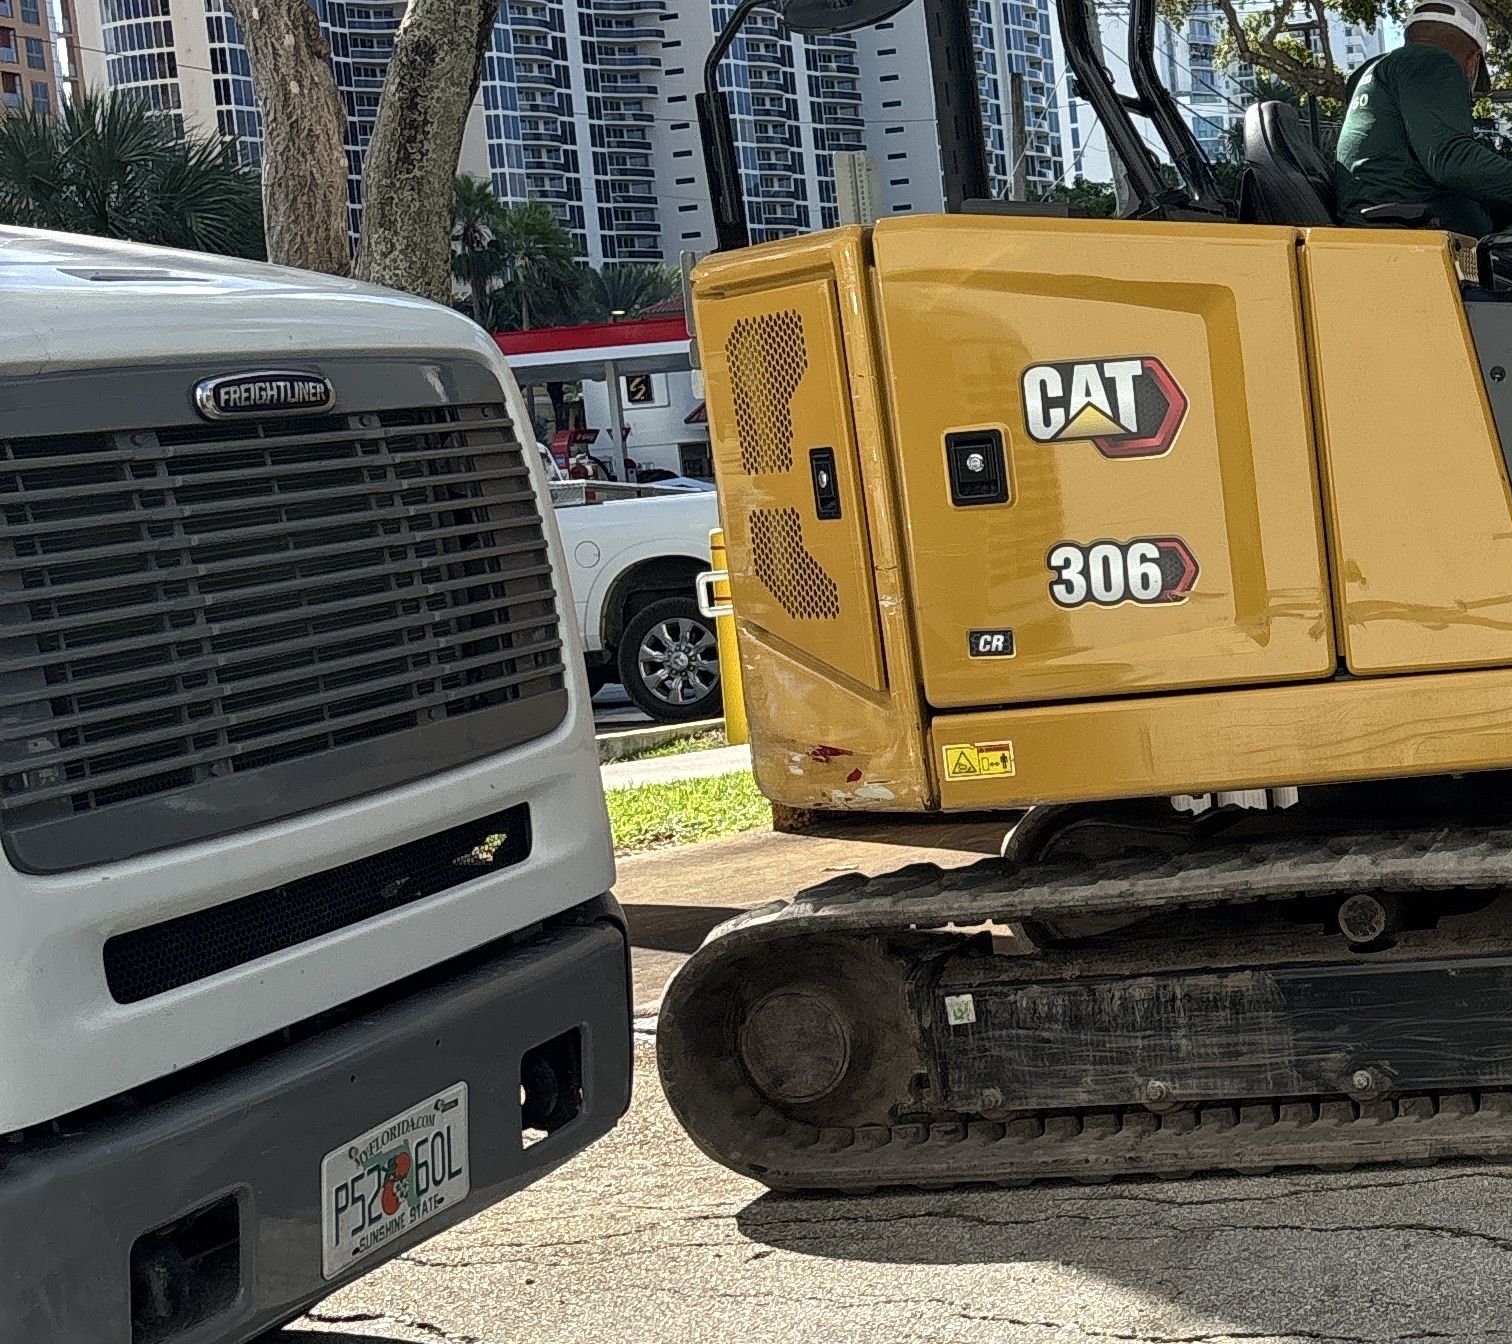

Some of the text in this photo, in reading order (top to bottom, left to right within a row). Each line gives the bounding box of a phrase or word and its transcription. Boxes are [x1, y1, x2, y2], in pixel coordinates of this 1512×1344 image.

[219, 380, 326, 408] FREIGHTLINER
[1023, 360, 1142, 440] CAT
[1050, 542, 1162, 604] 306
[978, 634, 1005, 652] CR
[358, 1192, 440, 1253] SUNSHINE STATE
